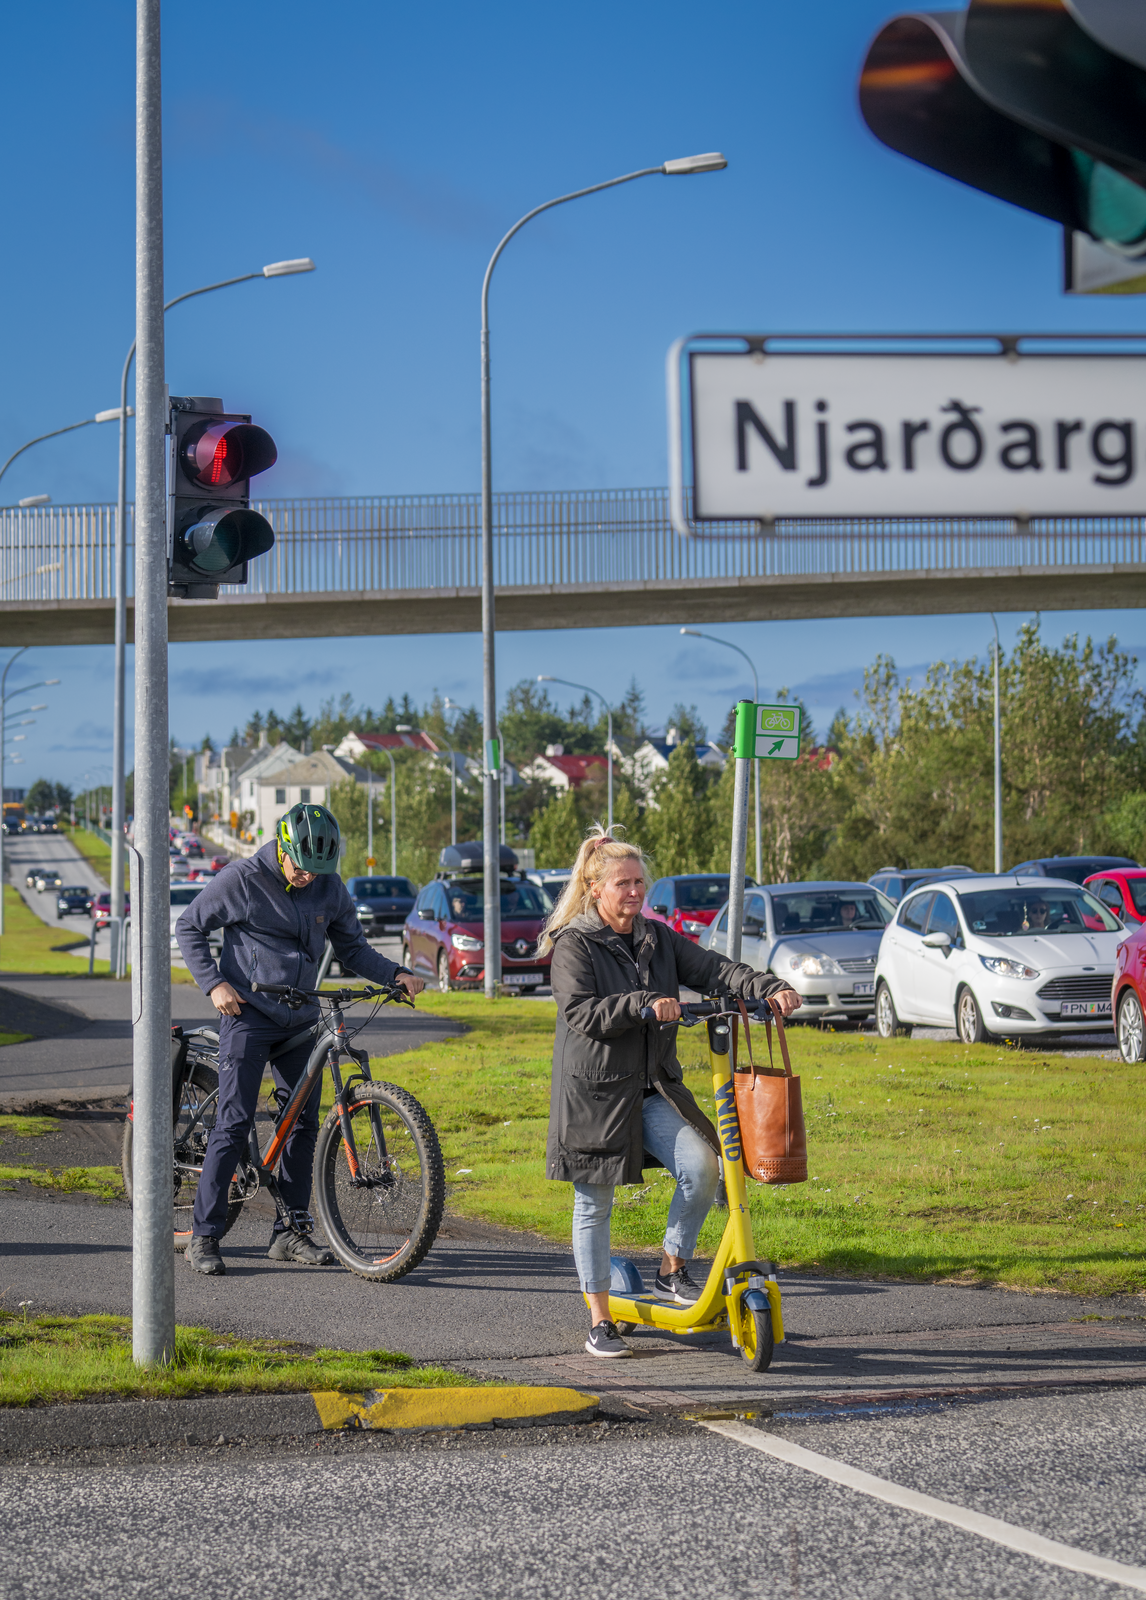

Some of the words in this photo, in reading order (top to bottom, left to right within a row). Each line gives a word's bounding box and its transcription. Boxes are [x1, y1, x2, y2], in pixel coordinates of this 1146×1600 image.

[734, 398, 1136, 488] Njarðarg
[1070, 1003, 1088, 1014] PN
[1097, 1002, 1112, 1013] M4
[714, 1078, 742, 1162] WIND
